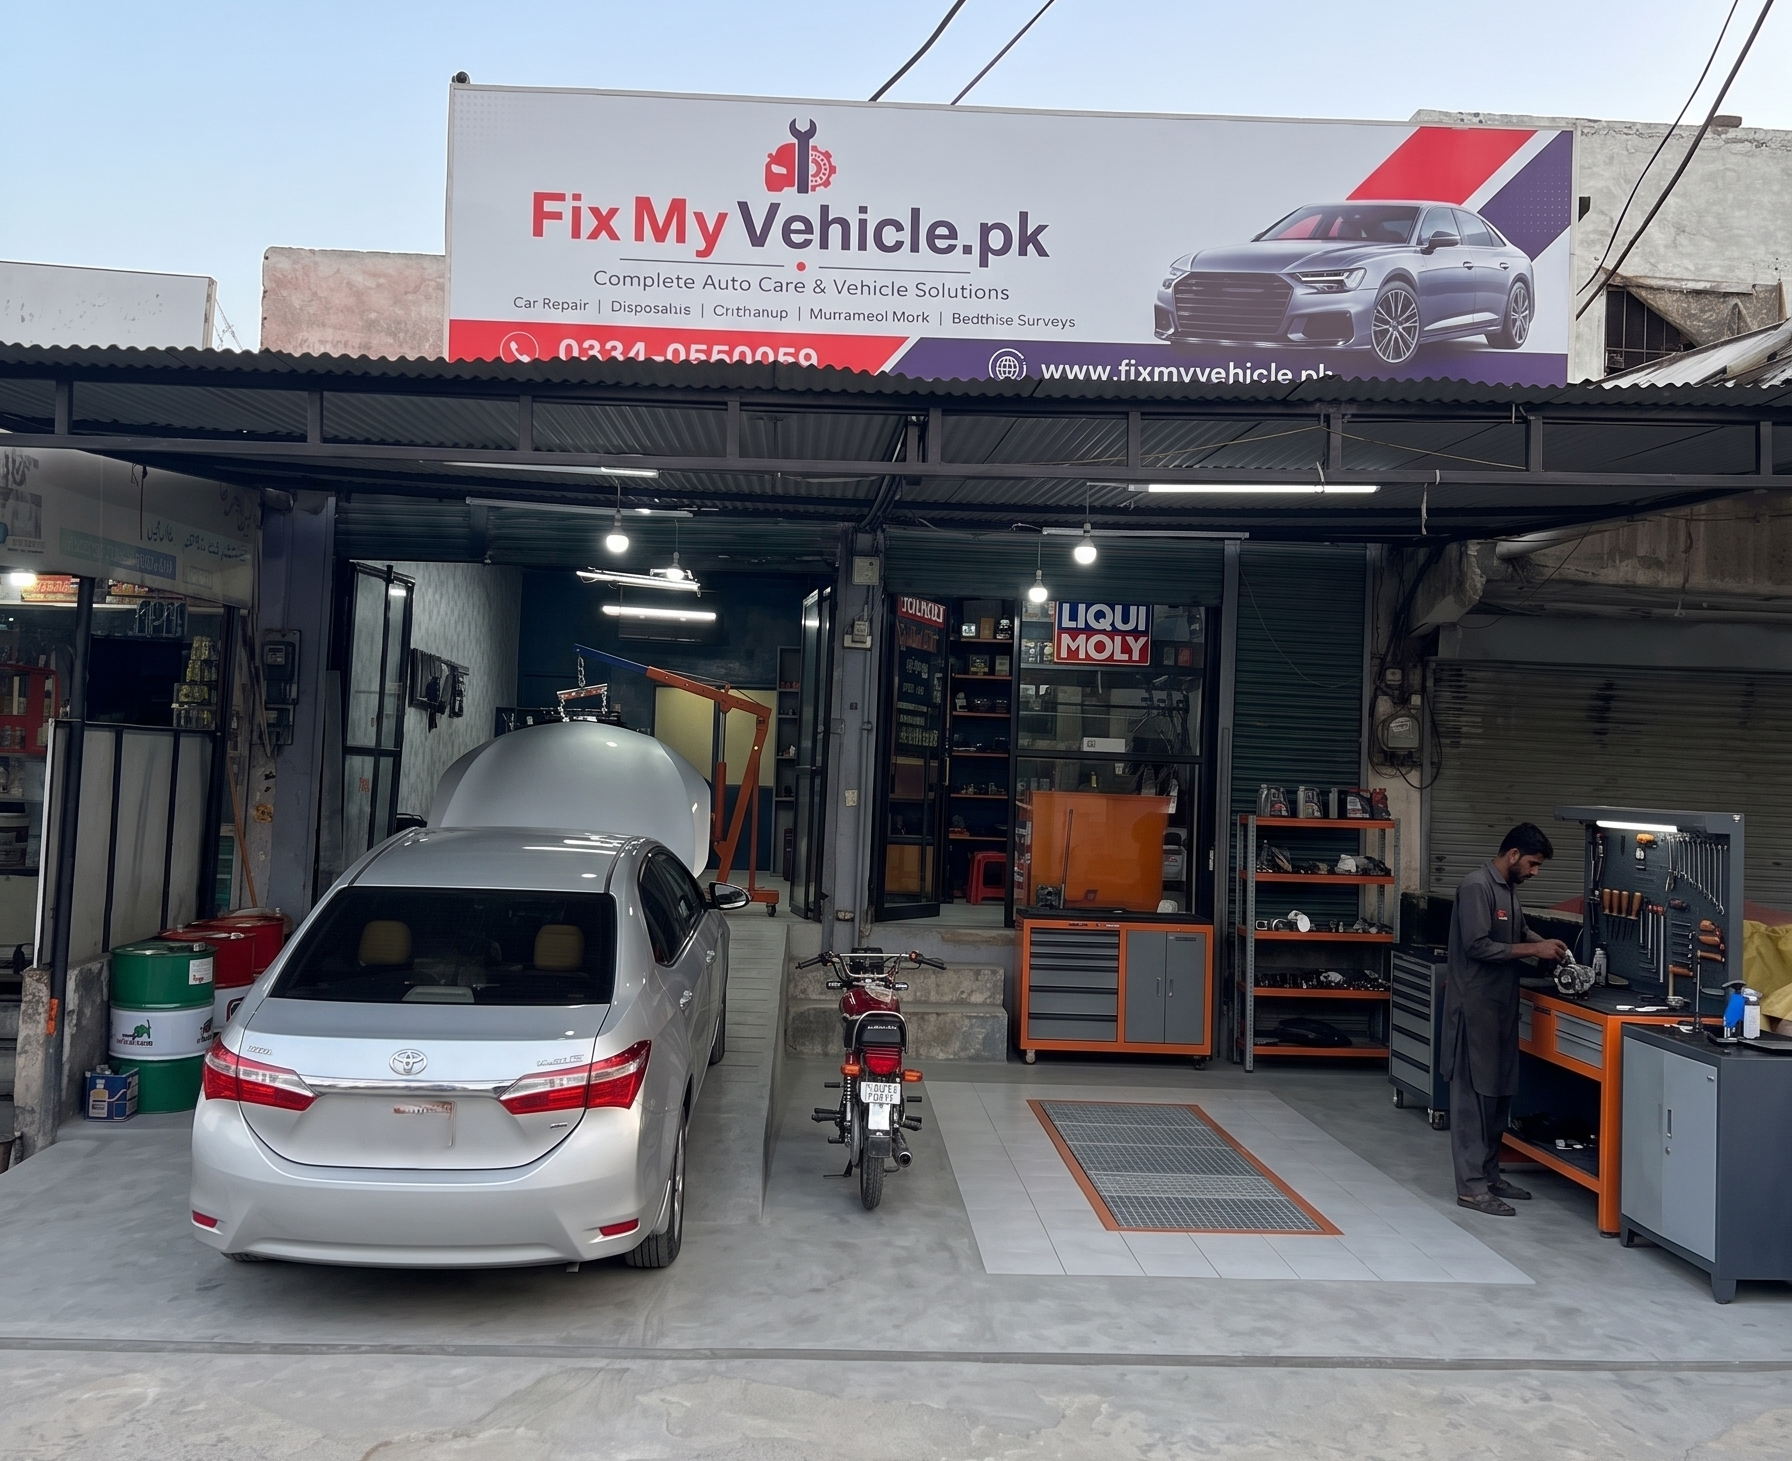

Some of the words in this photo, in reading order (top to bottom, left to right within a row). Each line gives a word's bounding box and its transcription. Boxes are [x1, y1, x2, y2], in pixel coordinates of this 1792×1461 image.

[533, 191, 621, 241] Fix
[634, 196, 729, 258] My
[737, 201, 1050, 268] Vehicle.pk
[594, 270, 696, 292] Complete
[702, 274, 752, 293] Auto
[758, 276, 806, 295] Care
[812, 278, 827, 295] &
[833, 279, 908, 298] Vehicle
[915, 281, 1010, 301] Solutions
[513, 296, 539, 310] Car
[542, 297, 590, 313] Repair
[809, 307, 888, 323] Murrameol
[892, 310, 930, 324] Mork
[952, 312, 1014, 327] Bedthise
[1017, 314, 1076, 331] Surveys
[1061, 603, 1147, 631] LIQUI
[1060, 633, 1149, 661] MOLY
